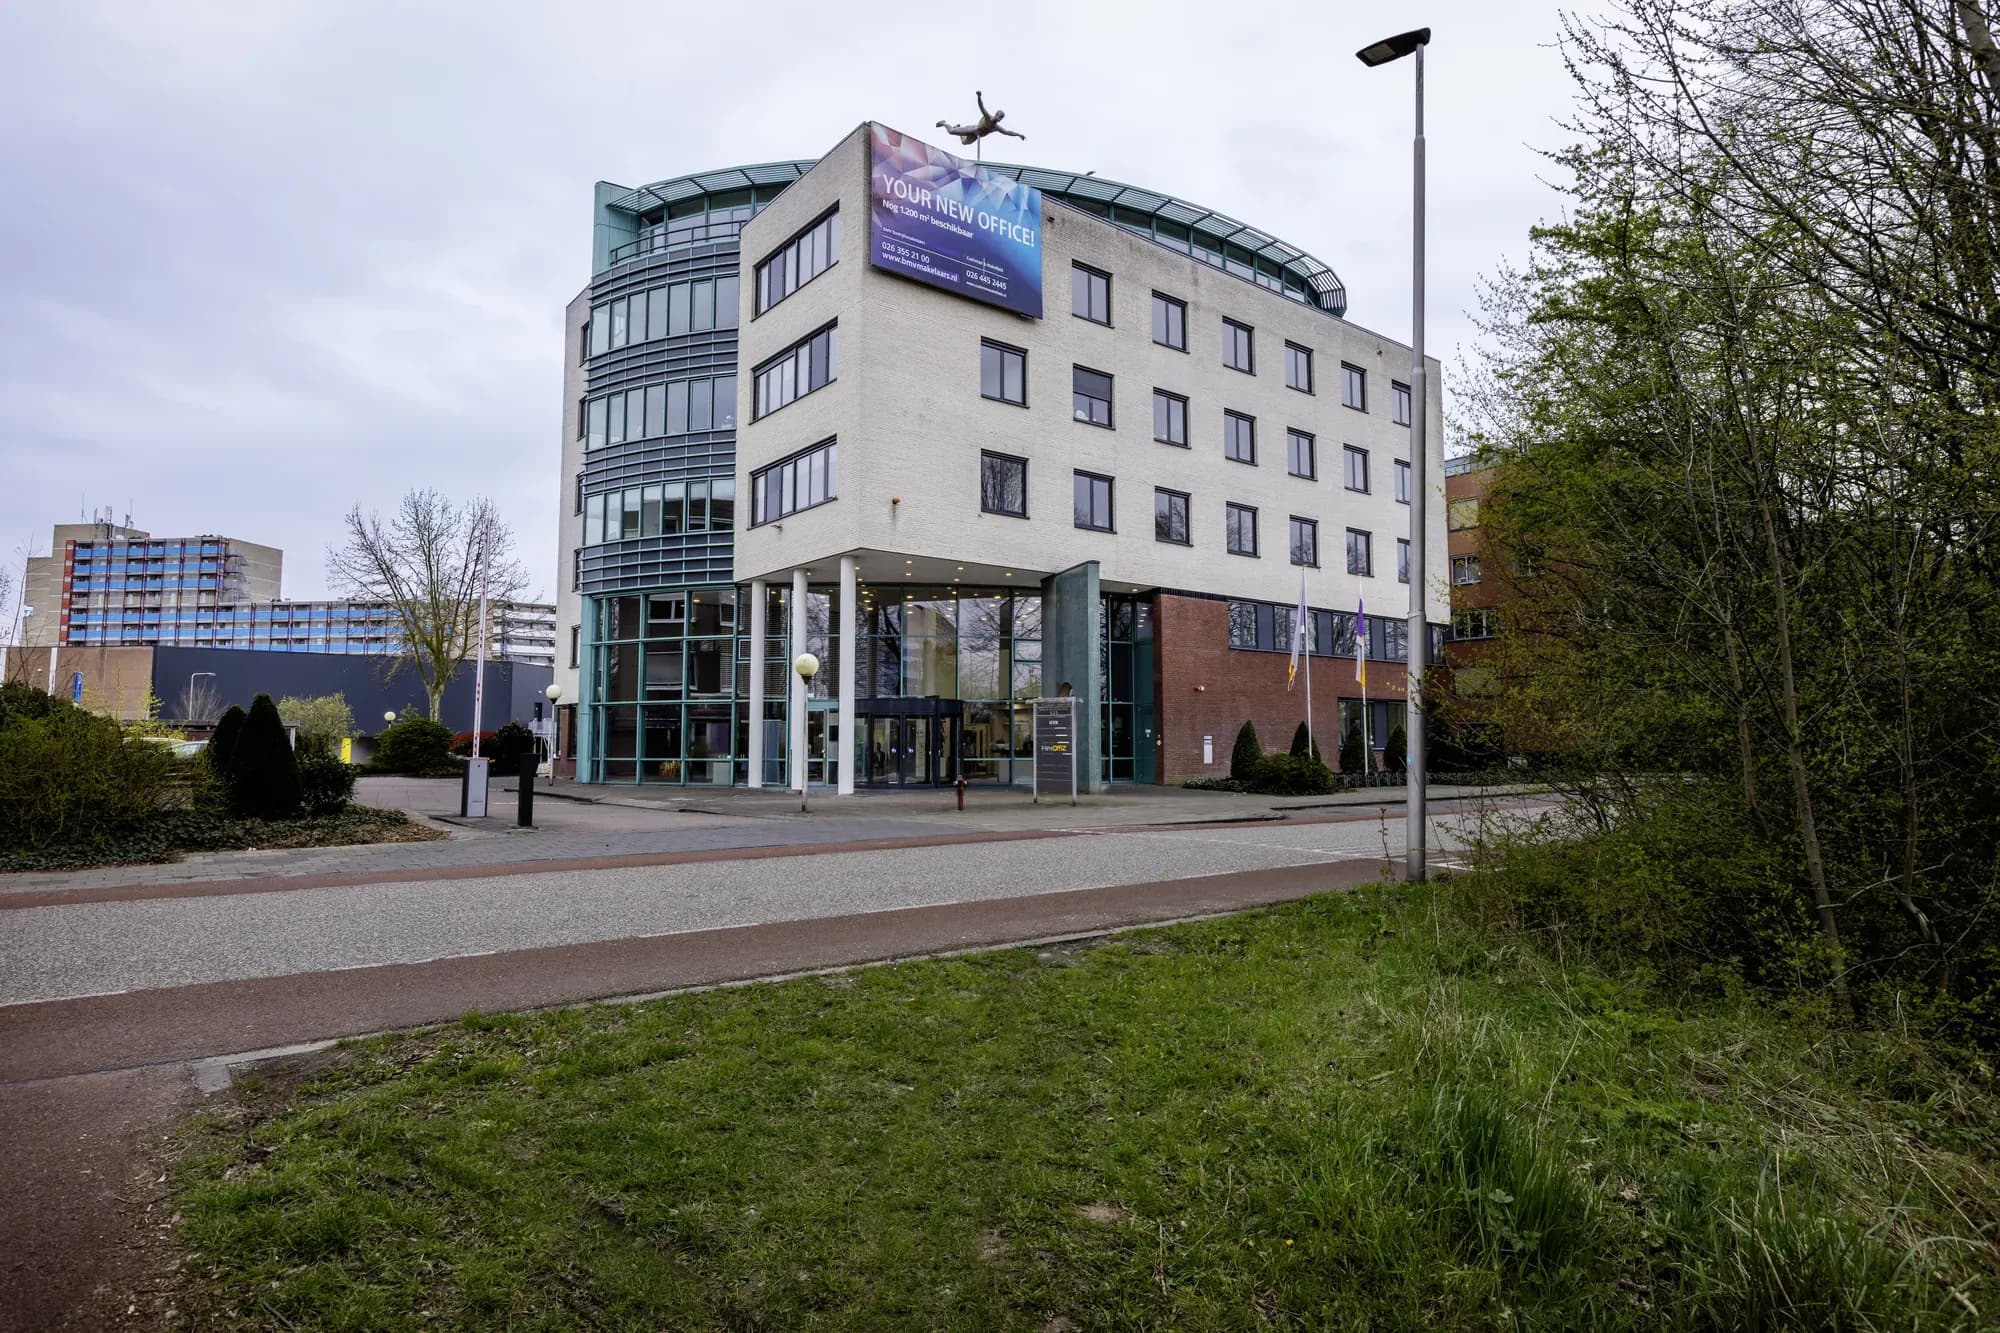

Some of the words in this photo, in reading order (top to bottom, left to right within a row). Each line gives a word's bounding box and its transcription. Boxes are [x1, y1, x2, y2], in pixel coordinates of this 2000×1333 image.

[882, 200, 899, 213] Nog
[899, 205, 919, 218] 1.200
[931, 215, 974, 239] beschikbaar
[883, 174, 931, 209] YOUR
[936, 195, 974, 224] NEW
[977, 211, 1035, 248] OFFICE!
[881, 241, 895, 252] 026
[896, 246, 910, 257] 355
[911, 251, 919, 260] 21
[920, 254, 930, 264] 00
[881, 251, 958, 282] www.bmvmakelaars.nl
[966, 269, 979, 280] 026
[979, 274, 991, 285] 445
